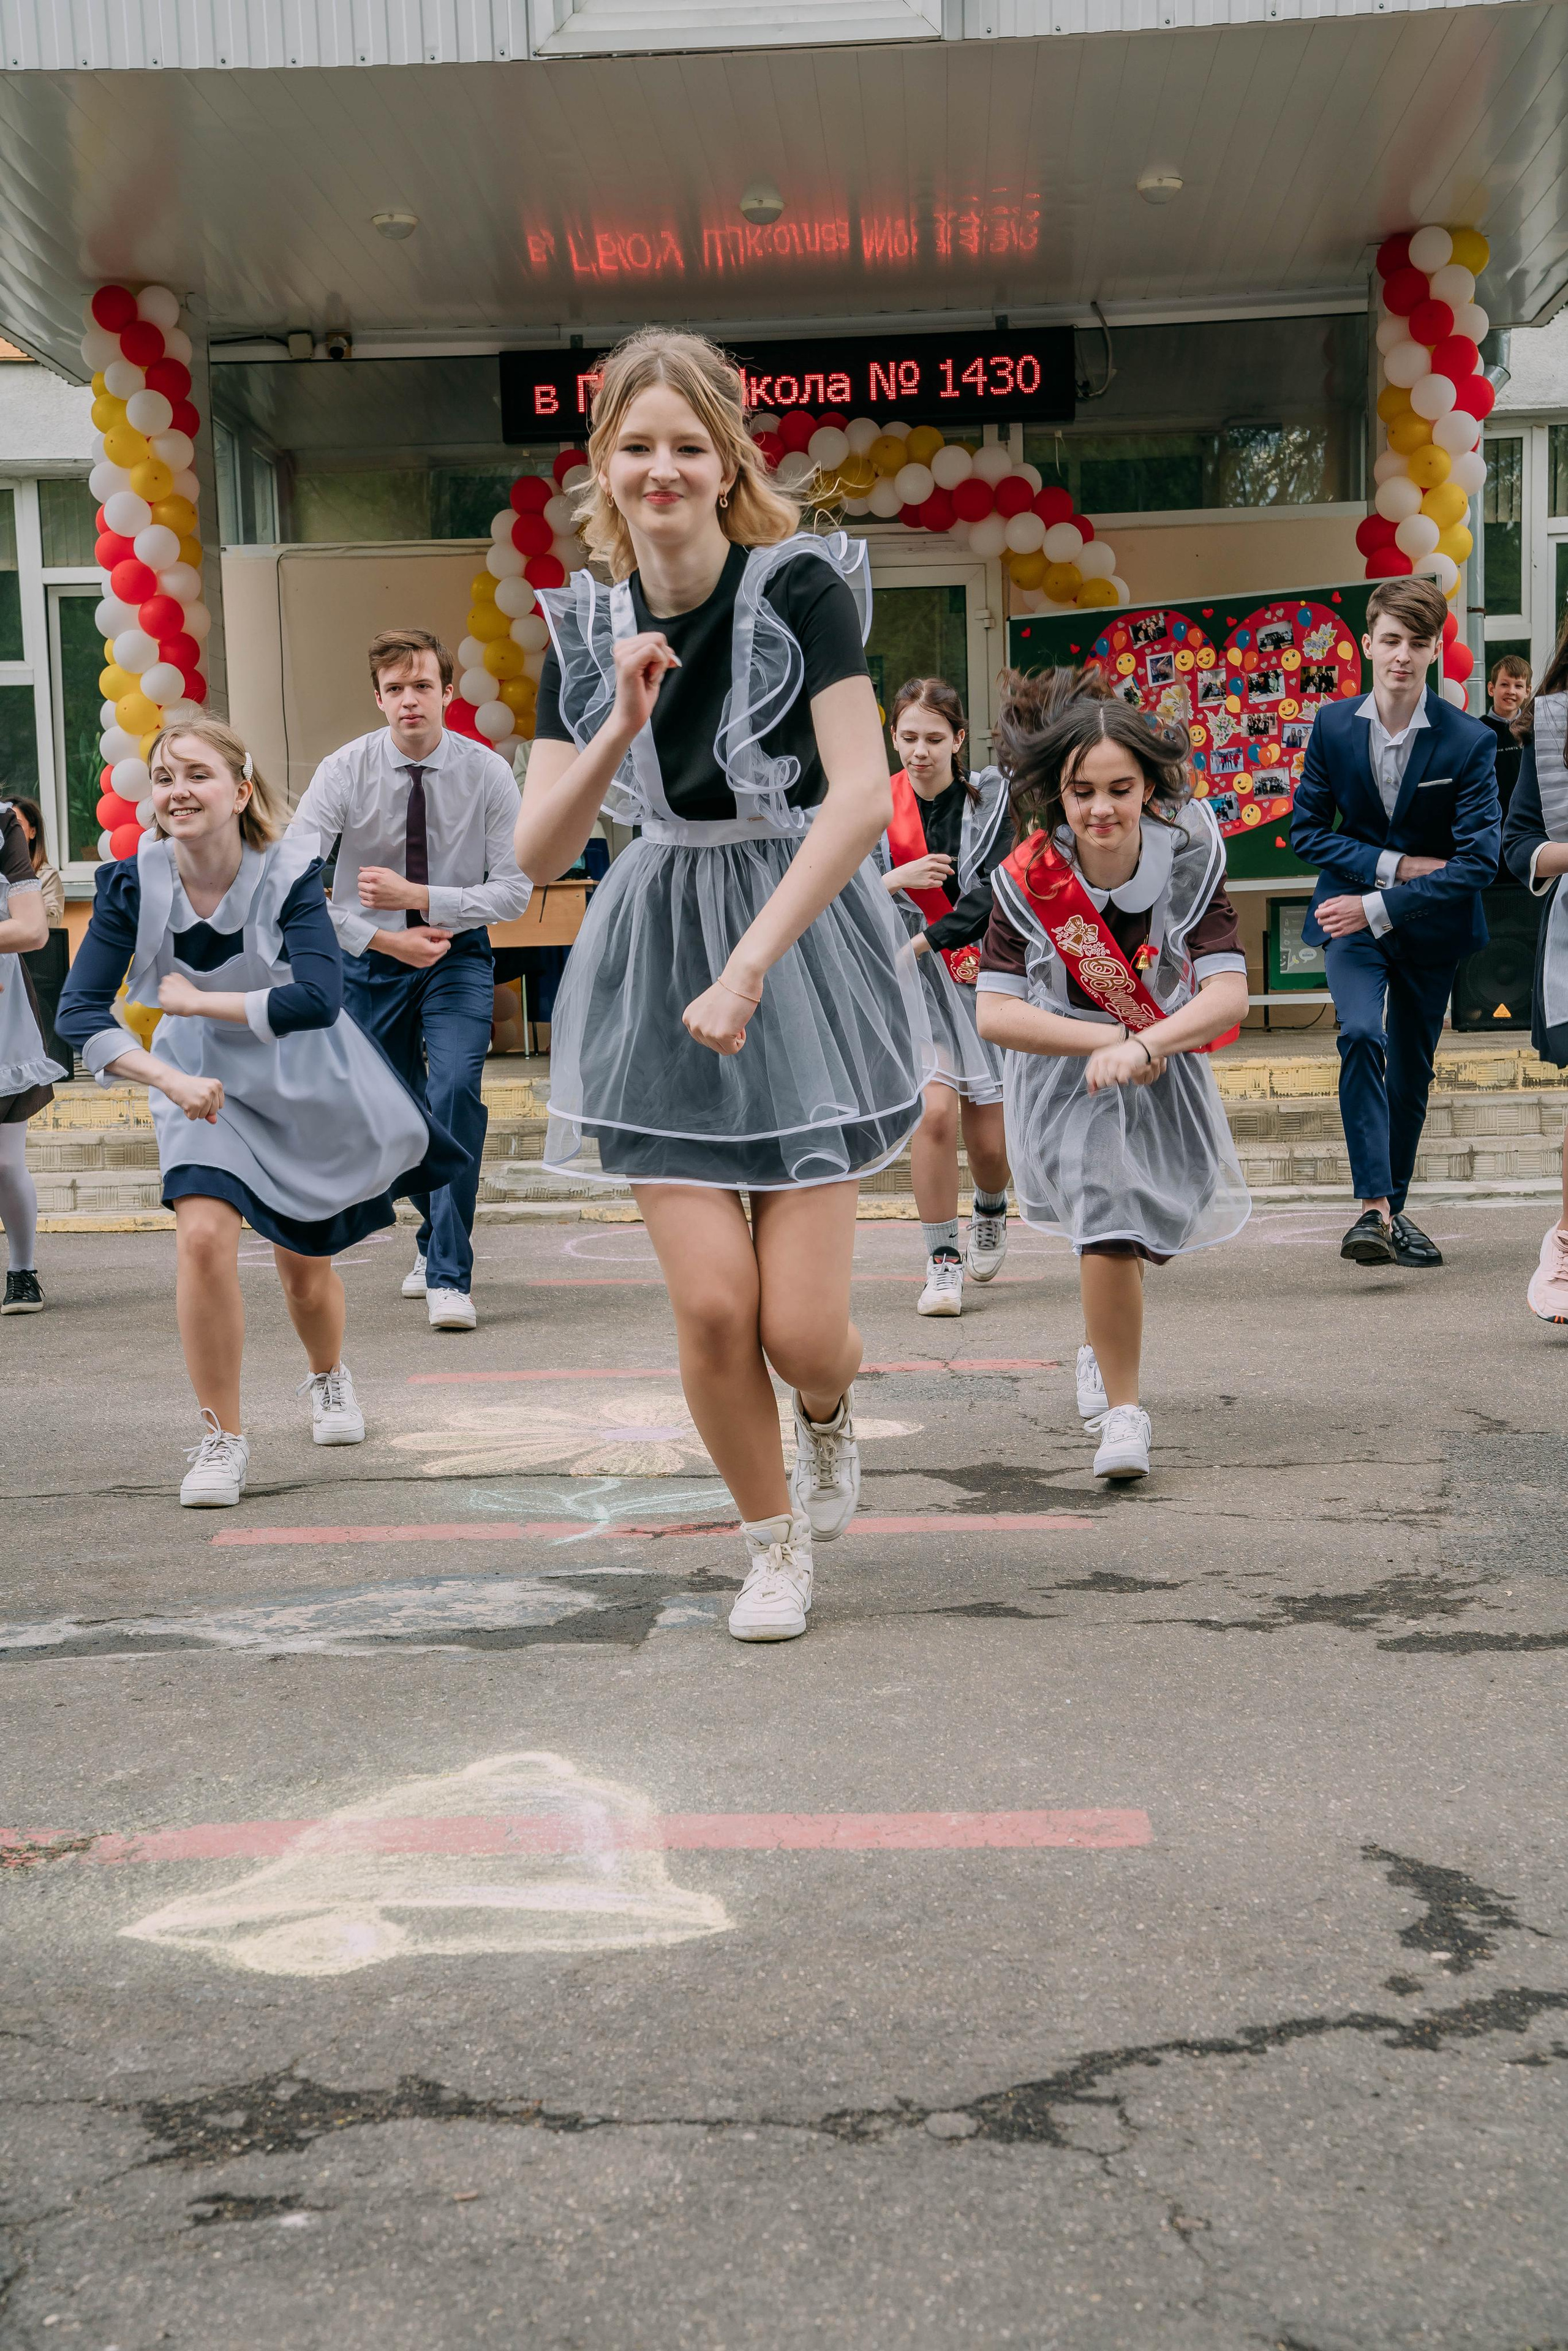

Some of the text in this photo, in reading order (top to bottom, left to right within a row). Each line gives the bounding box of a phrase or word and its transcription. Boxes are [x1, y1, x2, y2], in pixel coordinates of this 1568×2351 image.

[534, 385, 559, 414] в
[739, 368, 850, 406] кола
[869, 361, 919, 401] №
[939, 354, 1041, 398] 1430
